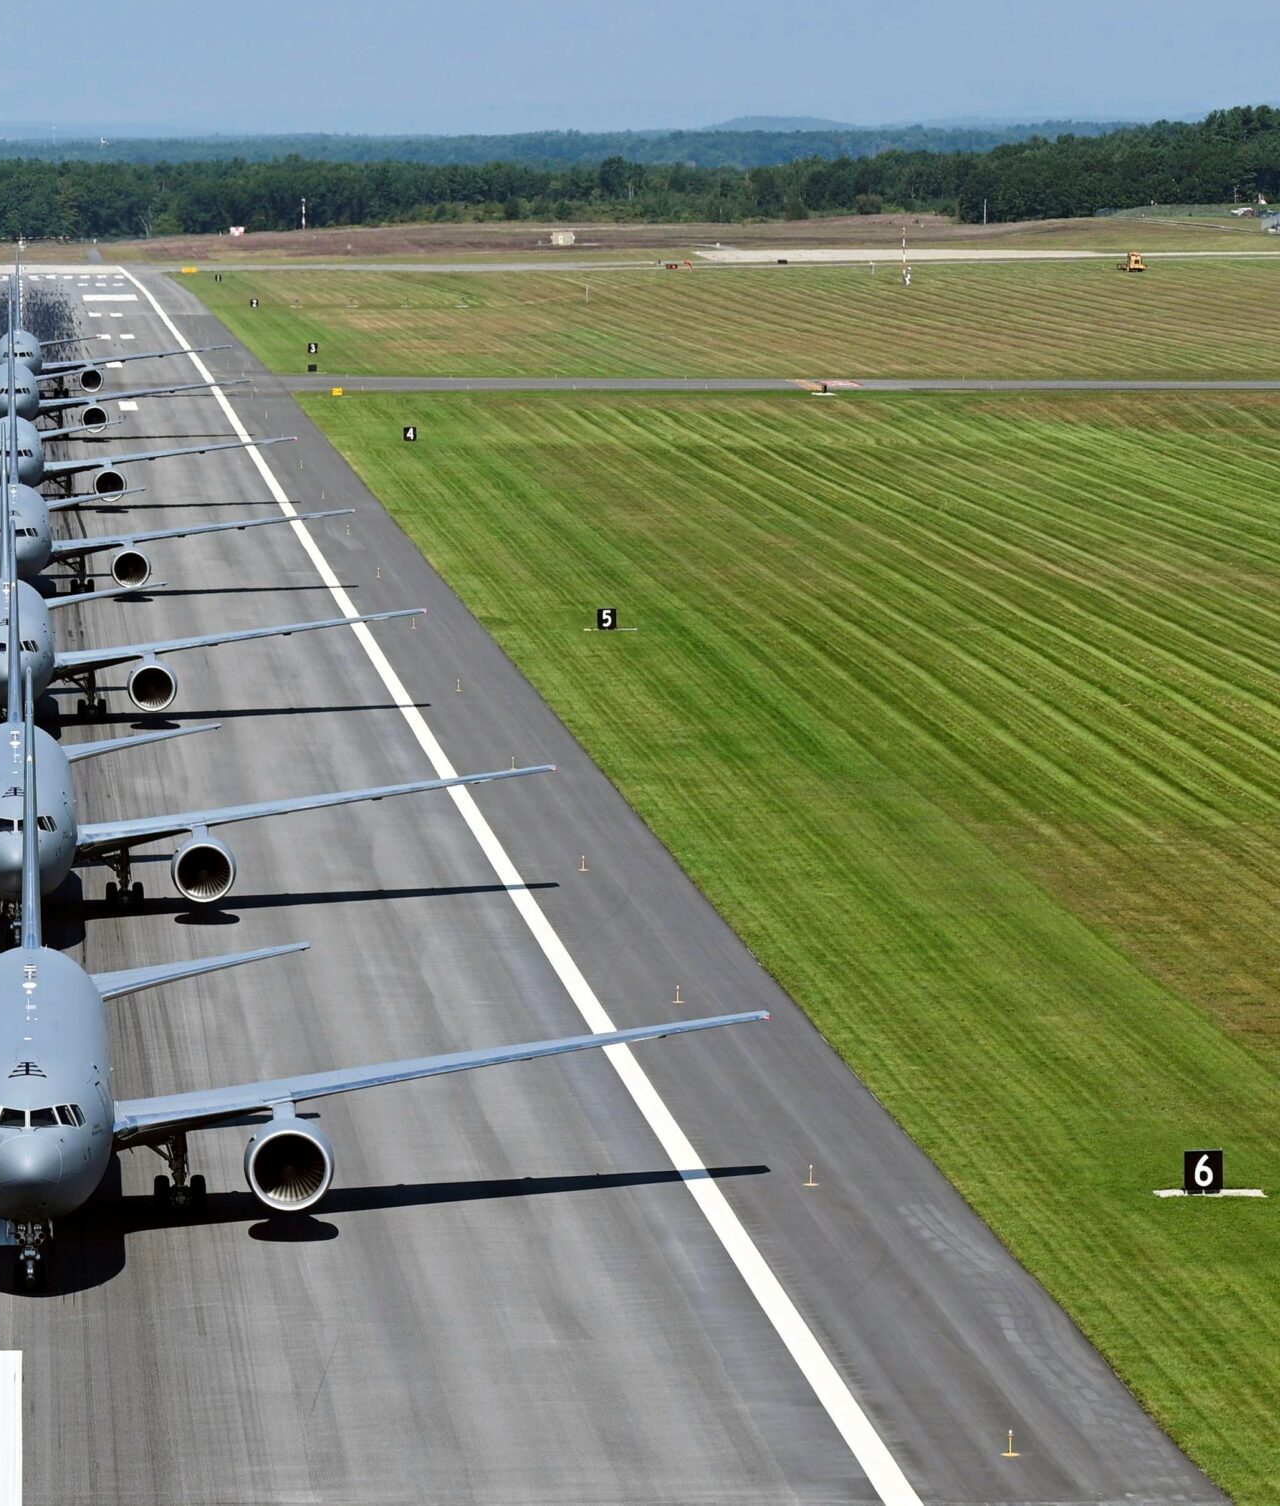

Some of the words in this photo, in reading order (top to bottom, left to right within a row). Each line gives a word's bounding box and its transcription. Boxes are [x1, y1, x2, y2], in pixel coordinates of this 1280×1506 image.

[310, 344, 315, 353] 3
[406, 428, 414, 440] 4
[602, 610, 611, 628] 5
[1194, 1153, 1214, 1187] 6
